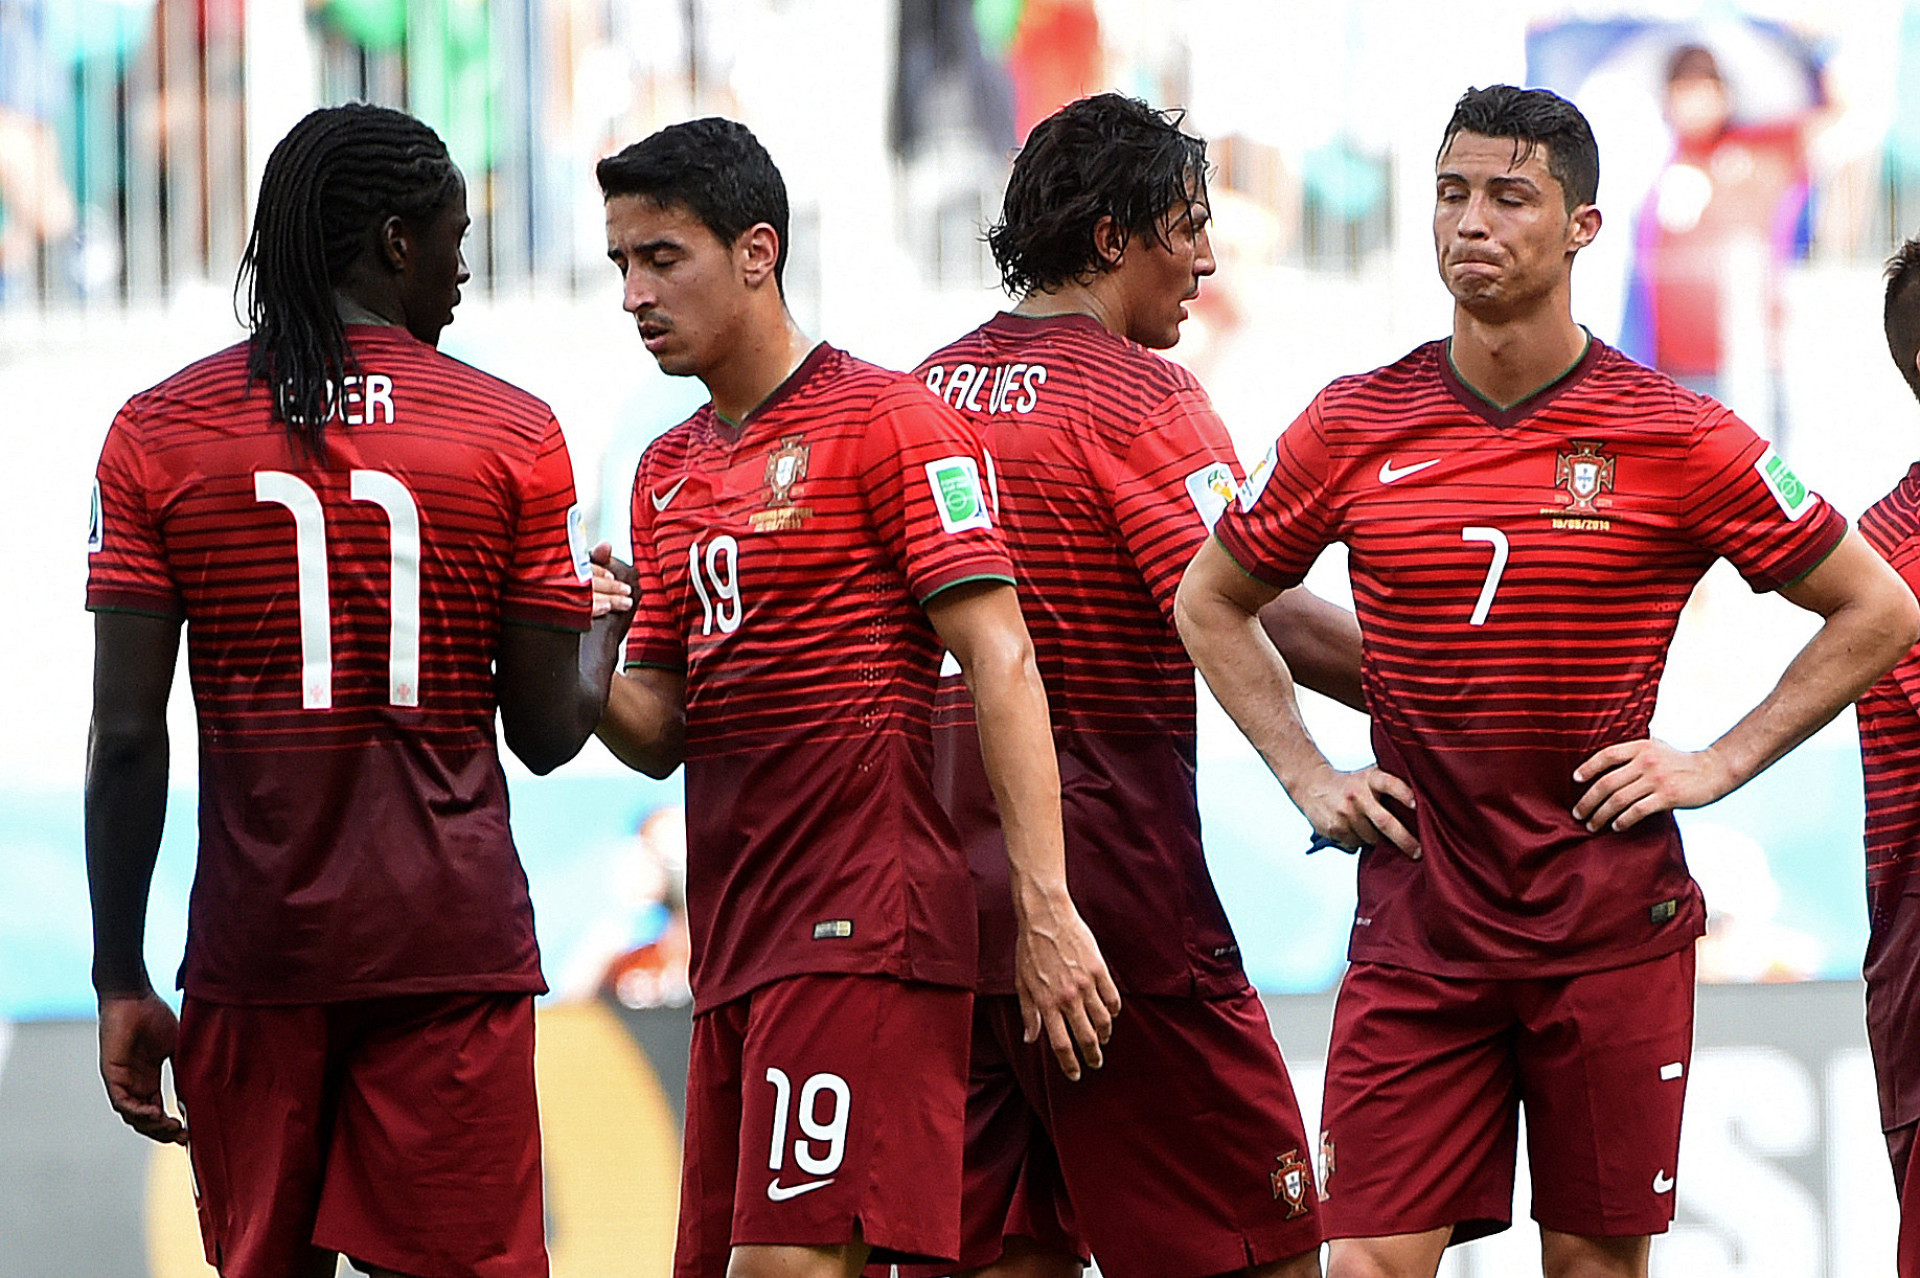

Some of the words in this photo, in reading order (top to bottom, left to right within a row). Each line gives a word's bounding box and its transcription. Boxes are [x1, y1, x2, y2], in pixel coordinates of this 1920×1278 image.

[253, 469, 421, 710] 11
[688, 534, 743, 636] 19
[1462, 526, 1510, 626] 7
[766, 1067, 851, 1176] 19
